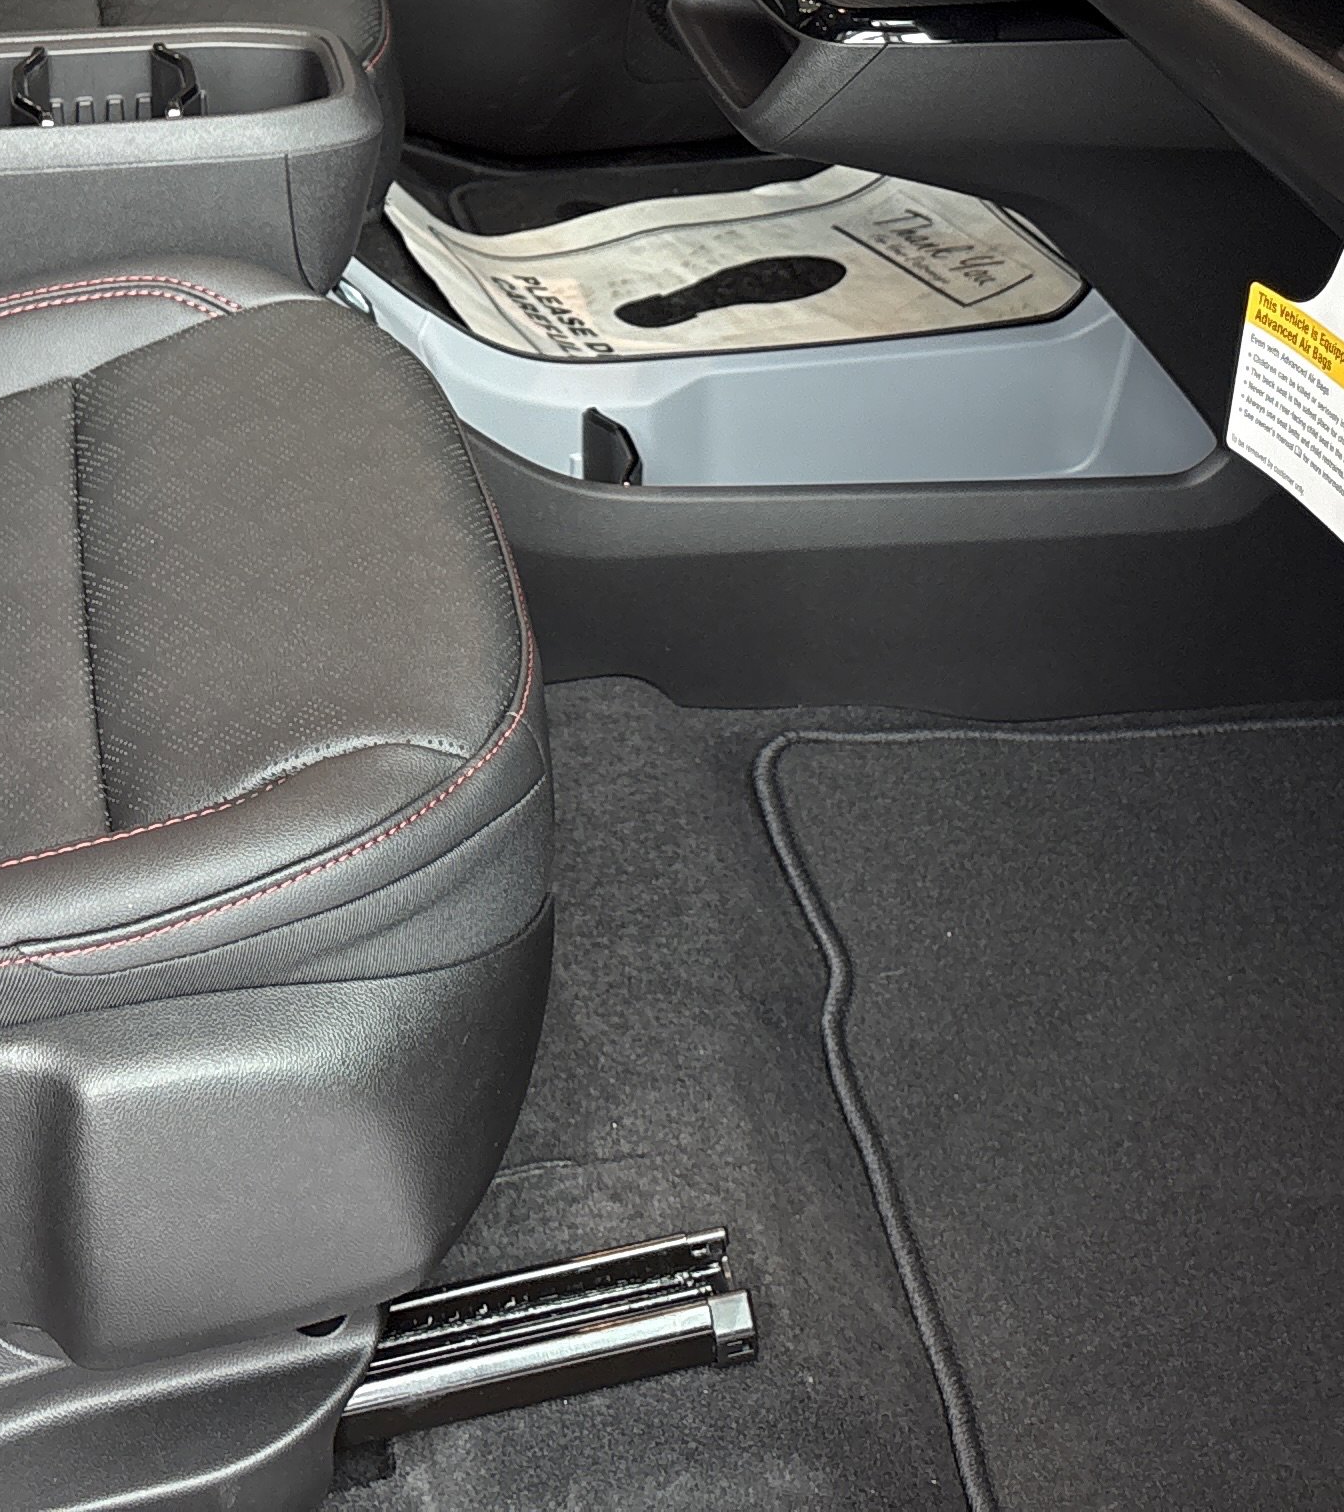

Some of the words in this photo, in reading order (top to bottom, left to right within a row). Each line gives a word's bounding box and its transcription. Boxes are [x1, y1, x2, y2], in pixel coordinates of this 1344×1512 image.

[871, 208, 975, 260] Thank
[490, 275, 583, 355] CAREFUL
[512, 275, 599, 338] PLEASE
[1259, 291, 1277, 313] This
[1280, 304, 1309, 335] Vehicle
[1255, 308, 1298, 346] Advanced
[1298, 337, 1311, 354] Air
[1312, 346, 1332, 371] Bags
